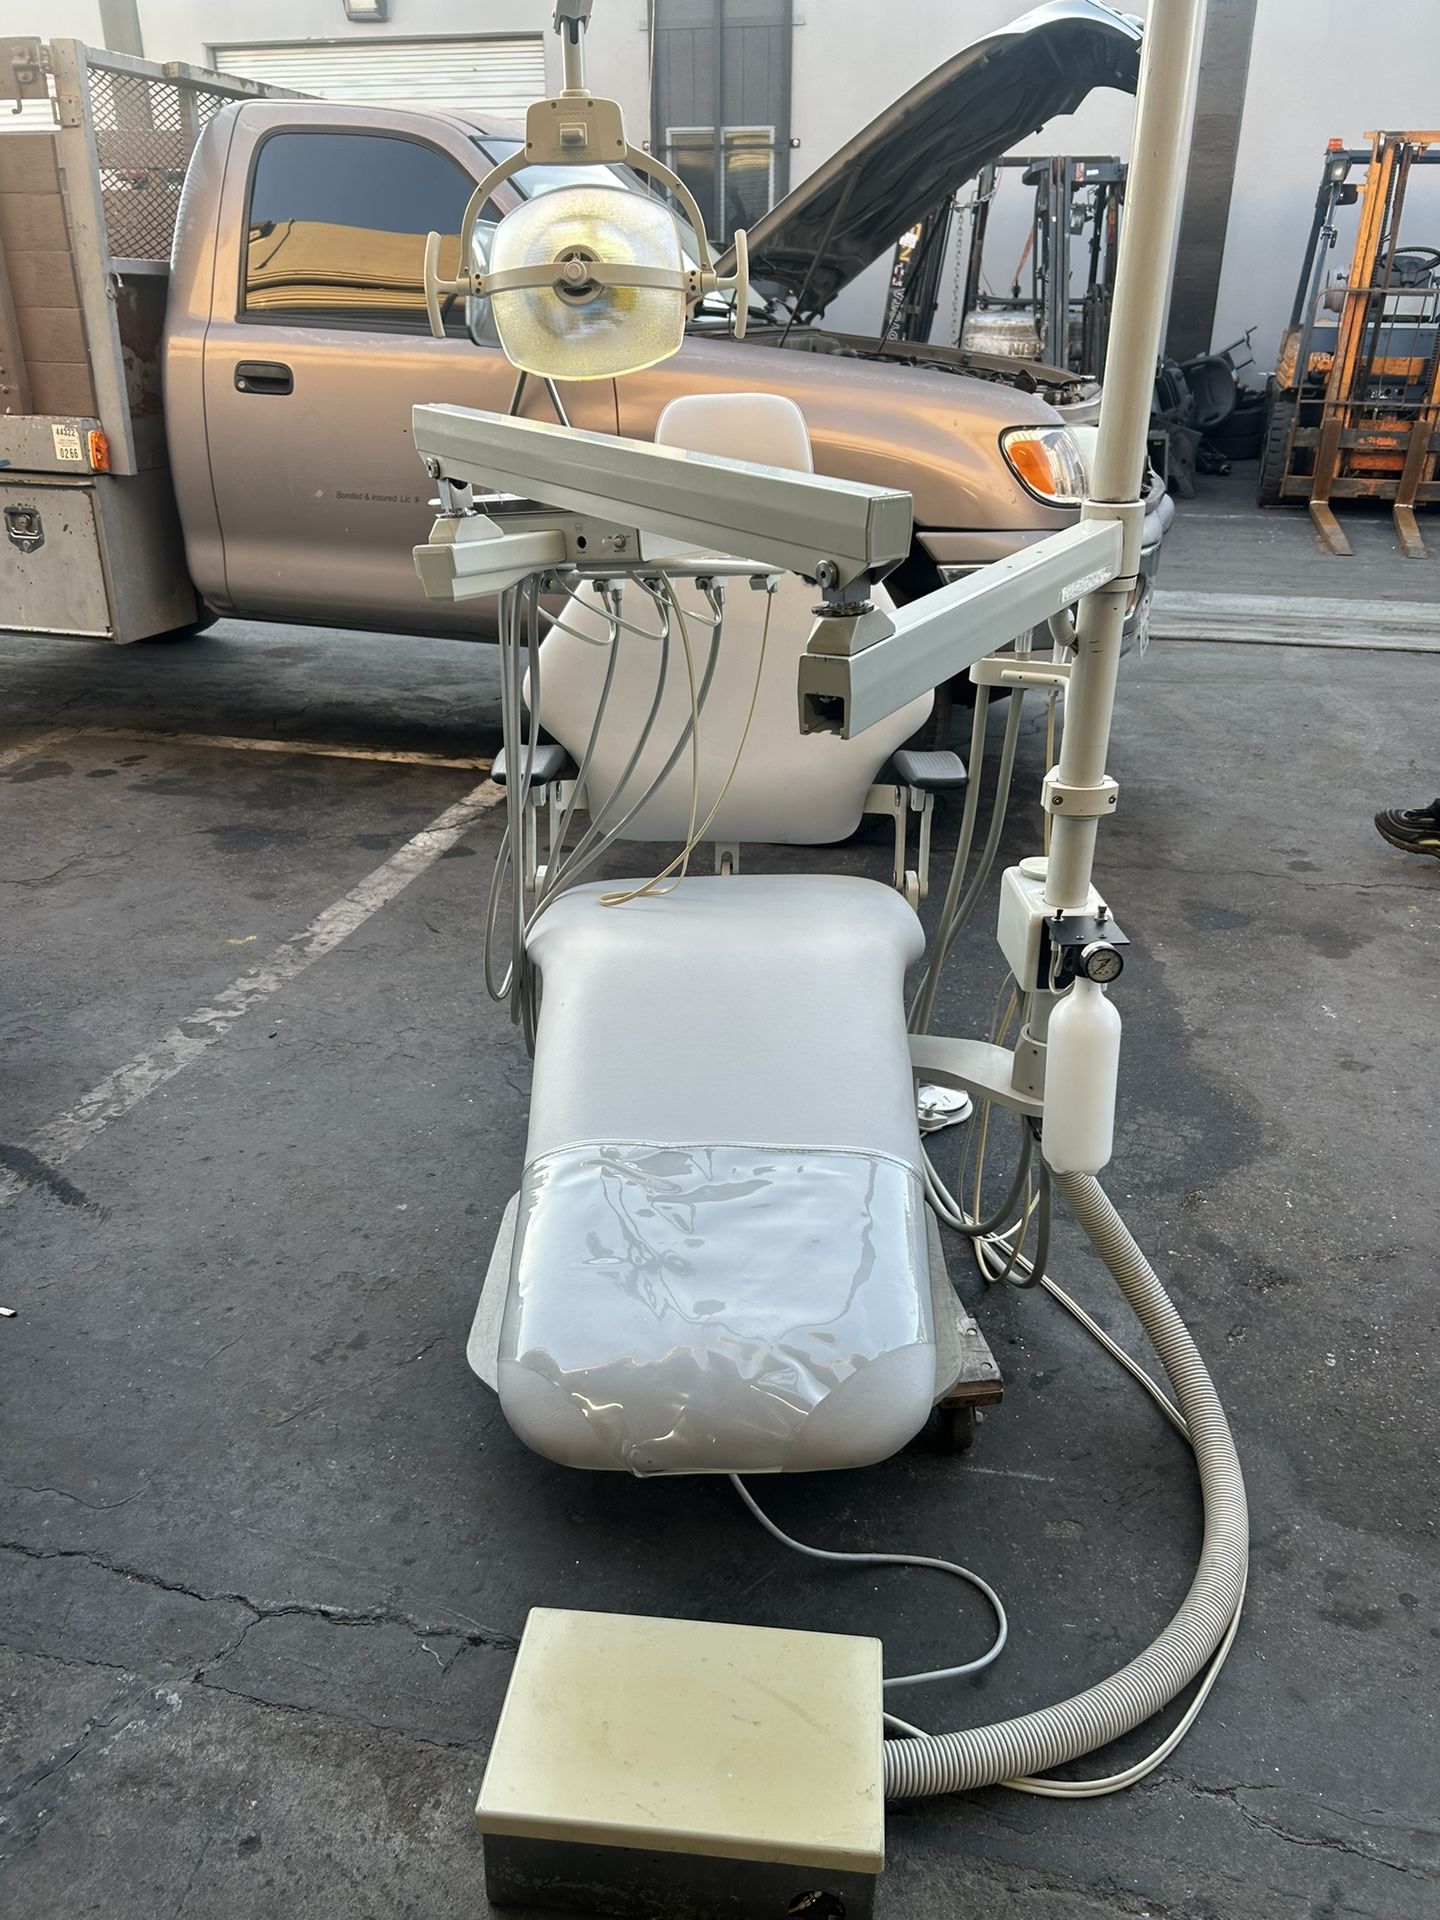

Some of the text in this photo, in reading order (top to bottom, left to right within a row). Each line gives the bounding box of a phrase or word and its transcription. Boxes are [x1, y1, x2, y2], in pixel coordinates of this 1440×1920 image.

[887, 287, 906, 341] OYOTA
[60, 447, 79, 459] 0266
[336, 490, 363, 500] Bonded
[364, 492, 370, 501] &
[372, 494, 398, 502] Insured
